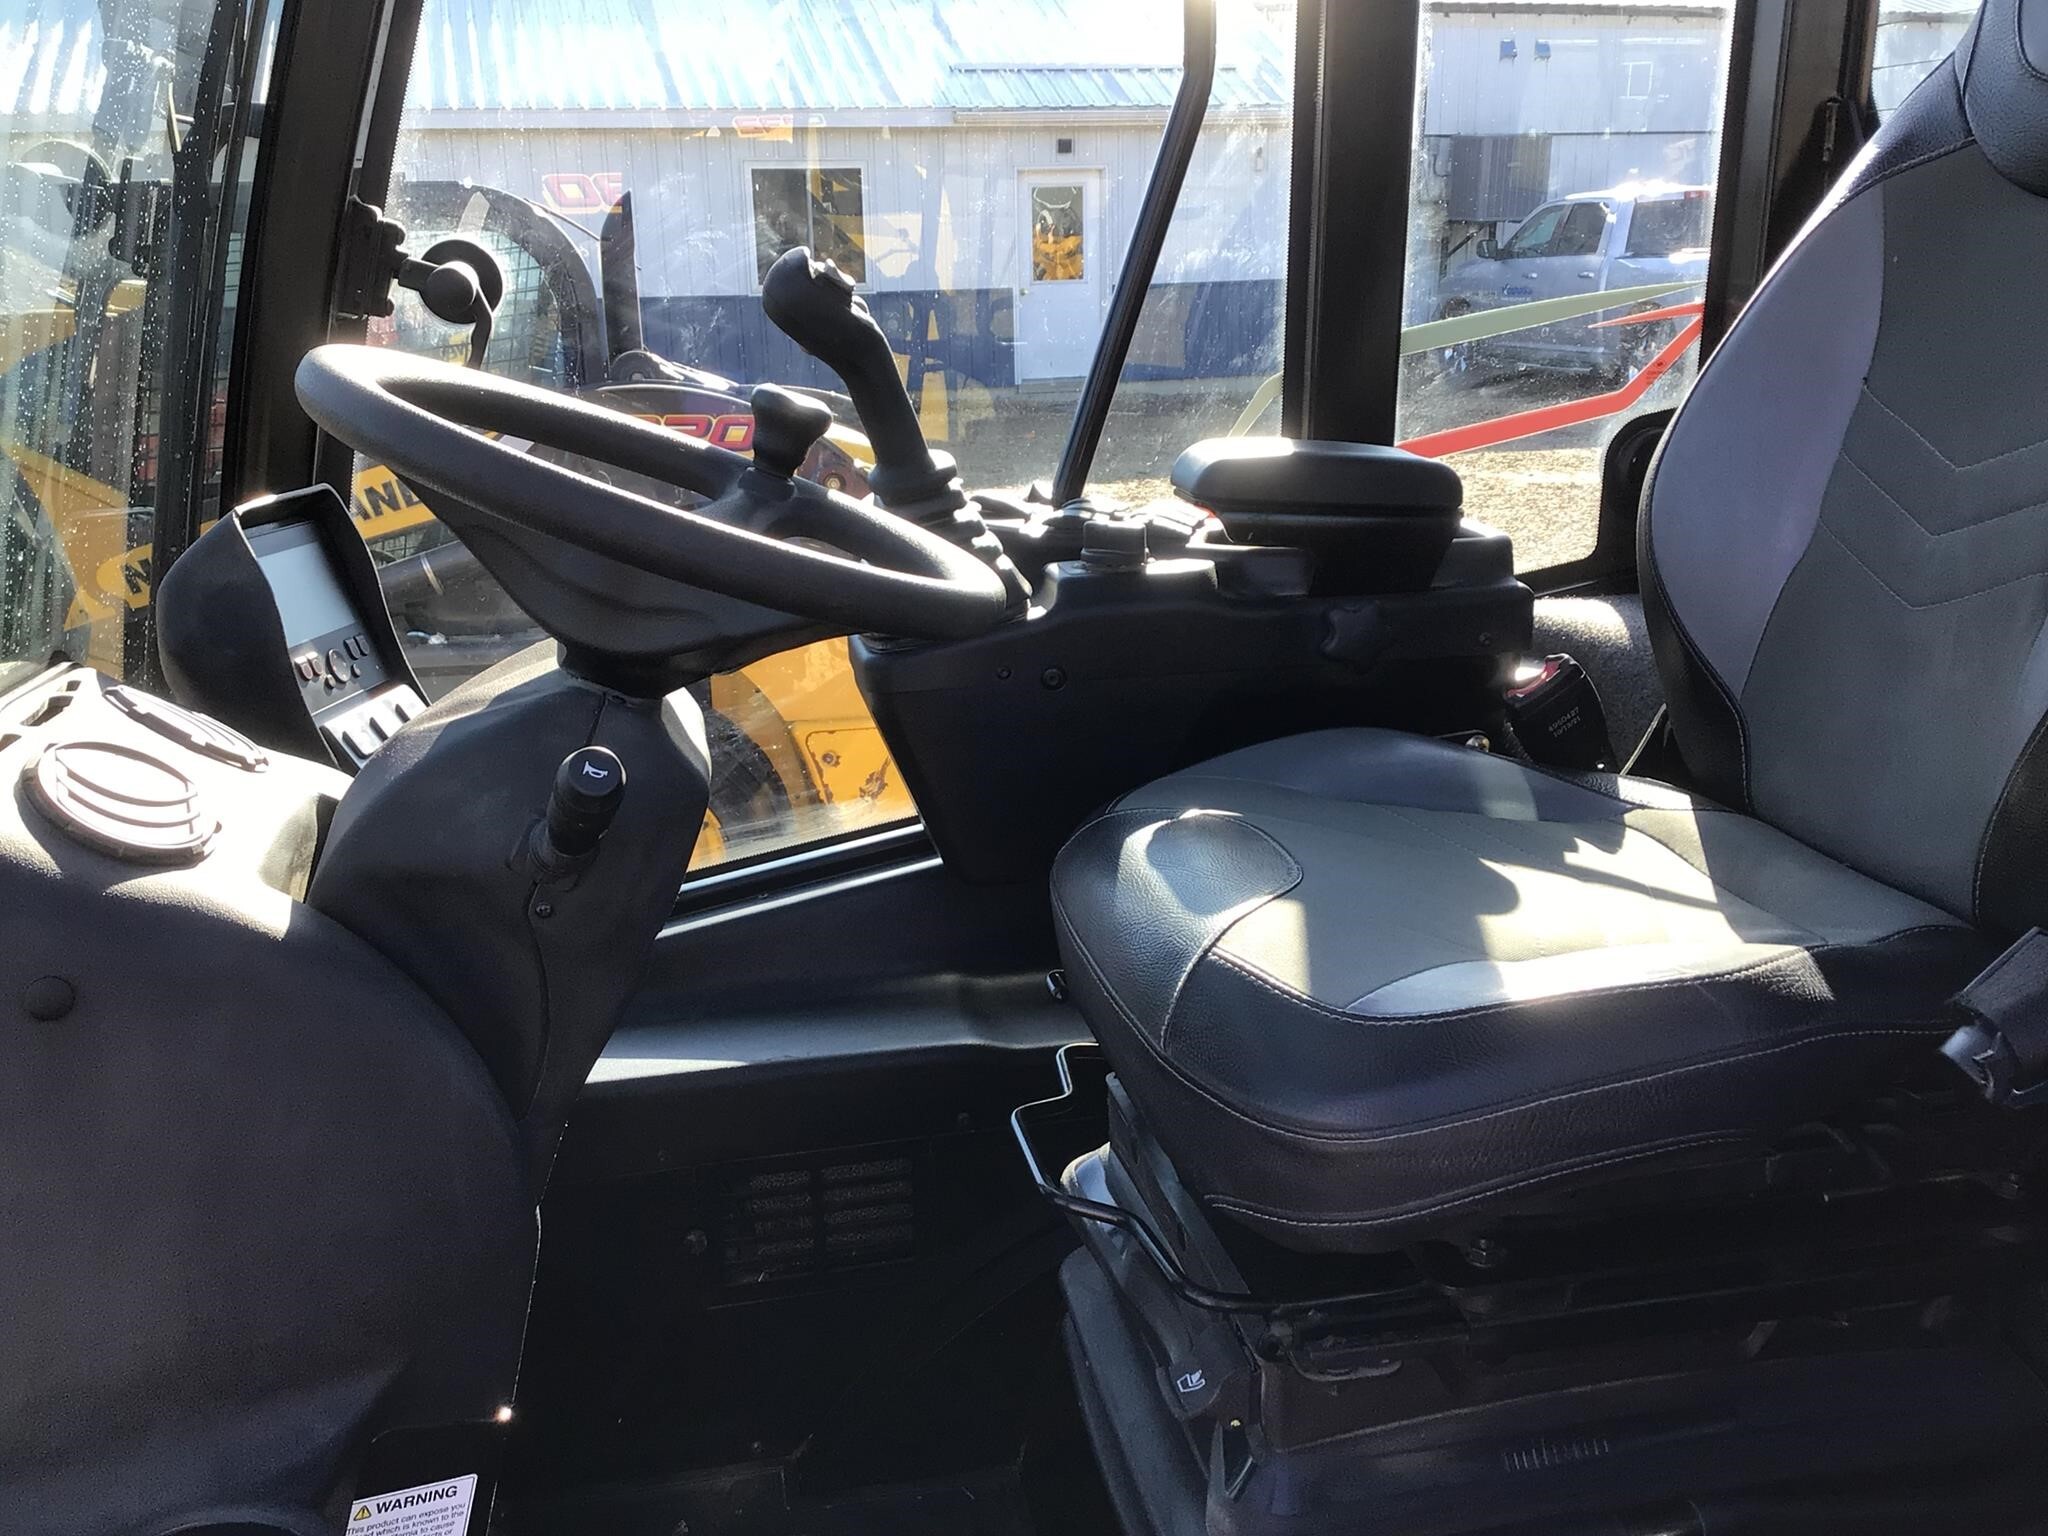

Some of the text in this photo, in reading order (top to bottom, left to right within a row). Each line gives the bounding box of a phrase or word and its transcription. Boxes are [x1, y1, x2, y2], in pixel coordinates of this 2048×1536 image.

[376, 1485, 458, 1514] WARNING
[366, 1517, 399, 1531] product
[401, 1514, 417, 1523] can
[419, 1506, 449, 1519] expose
[451, 1502, 466, 1512] you
